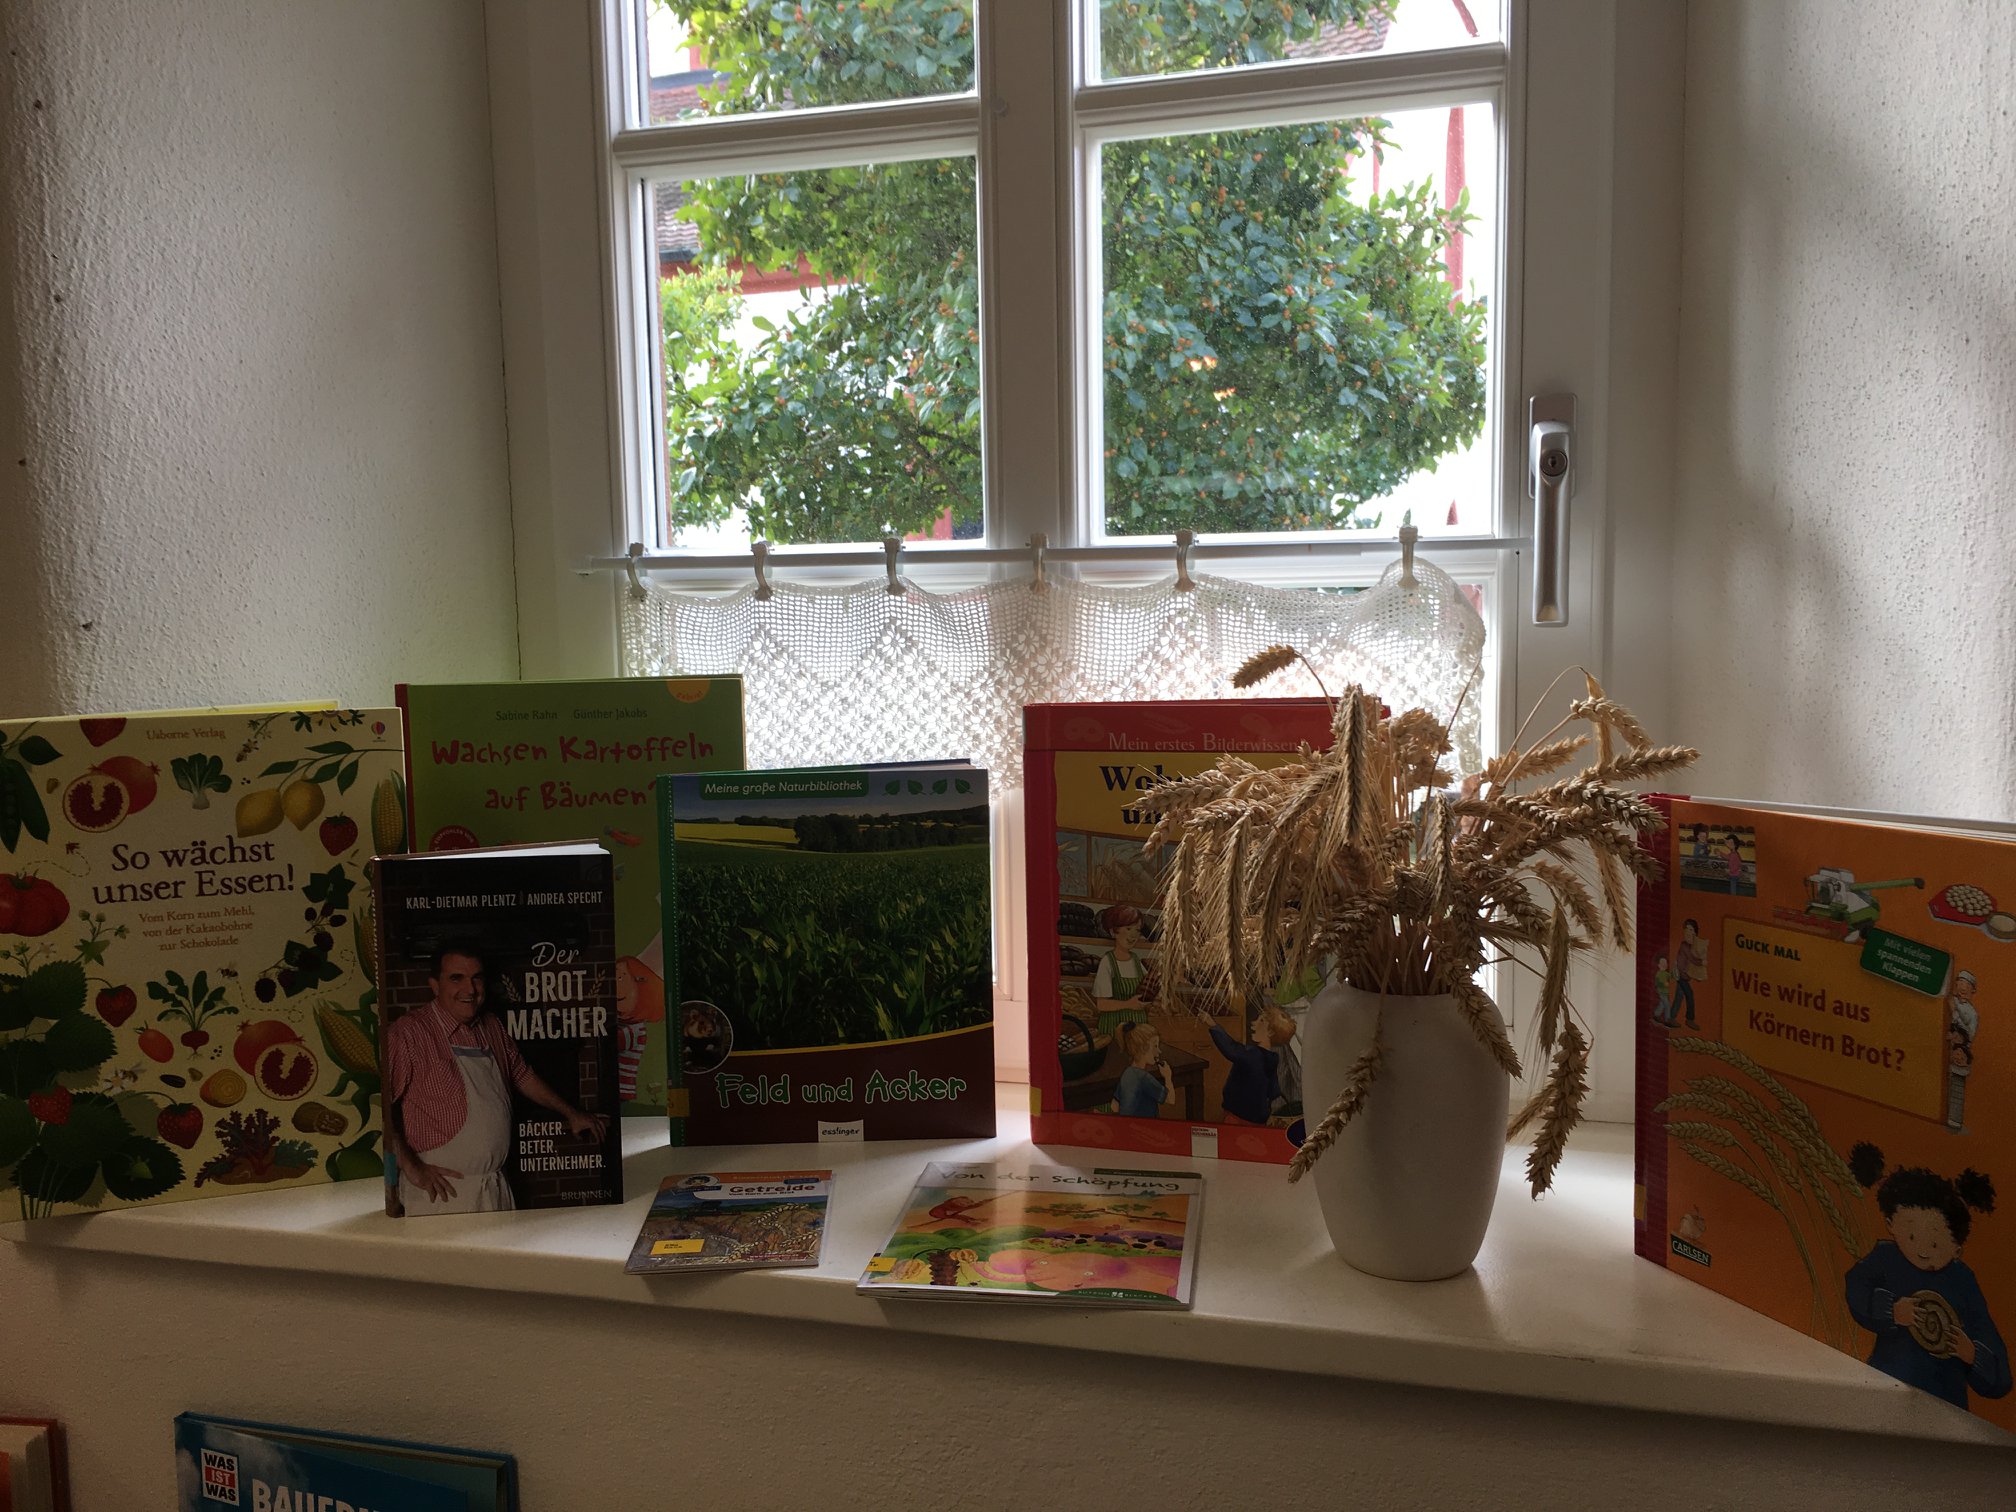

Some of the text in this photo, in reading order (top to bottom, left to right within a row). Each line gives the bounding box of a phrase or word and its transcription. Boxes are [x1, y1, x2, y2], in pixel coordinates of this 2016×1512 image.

[496, 707, 648, 721] Sabine Rahn Günther Jakobs
[192, 727, 226, 739] Verlag
[1108, 731, 1149, 751] Mein
[1154, 739, 1195, 751] erstes
[431, 731, 714, 766] Wachsen Kartoffeln
[484, 778, 657, 812] auf Bäumen
[704, 779, 863, 795] Meine große Naturbibliothek
[111, 835, 275, 871] So wächst
[92, 863, 294, 904] unser Essen!
[406, 890, 603, 910] KARL-DIETMAR PLENTZ ANDREA SPECHT
[139, 911, 164, 923] Vom
[166, 910, 195, 922] Korn
[197, 908, 221, 919] zum
[142, 921, 254, 938] von der Kakaobohne
[158, 935, 240, 951] zur Schokolade
[1884, 937, 1932, 962] Mit vielen
[530, 941, 580, 968] Der
[1876, 948, 1932, 975] spannenden
[1881, 960, 1920, 983] Klappen
[524, 969, 587, 1003] BROT
[1731, 967, 1871, 1024] Wie wird aus
[506, 1006, 609, 1041] MACHER
[1749, 1009, 1906, 1072] Körnern Brot?
[715, 1068, 967, 1108] Feld und Acker
[518, 1119, 567, 1138] BÄCKER.
[821, 1127, 861, 1137] esslinger
[519, 1139, 558, 1155] BETER.
[520, 1154, 607, 1172] UNTERNEHMER.
[729, 1183, 816, 1194] Getreide
[941, 1170, 986, 1180] Von
[997, 1172, 1036, 1182] der
[1052, 1174, 1180, 1192] Schöpfung
[560, 1189, 612, 1201] BRUNNEN
[1672, 1240, 1709, 1263] CARLSEN
[204, 1452, 235, 1471] WAS
[211, 1471, 232, 1485] IST
[207, 1485, 236, 1502] WAS
